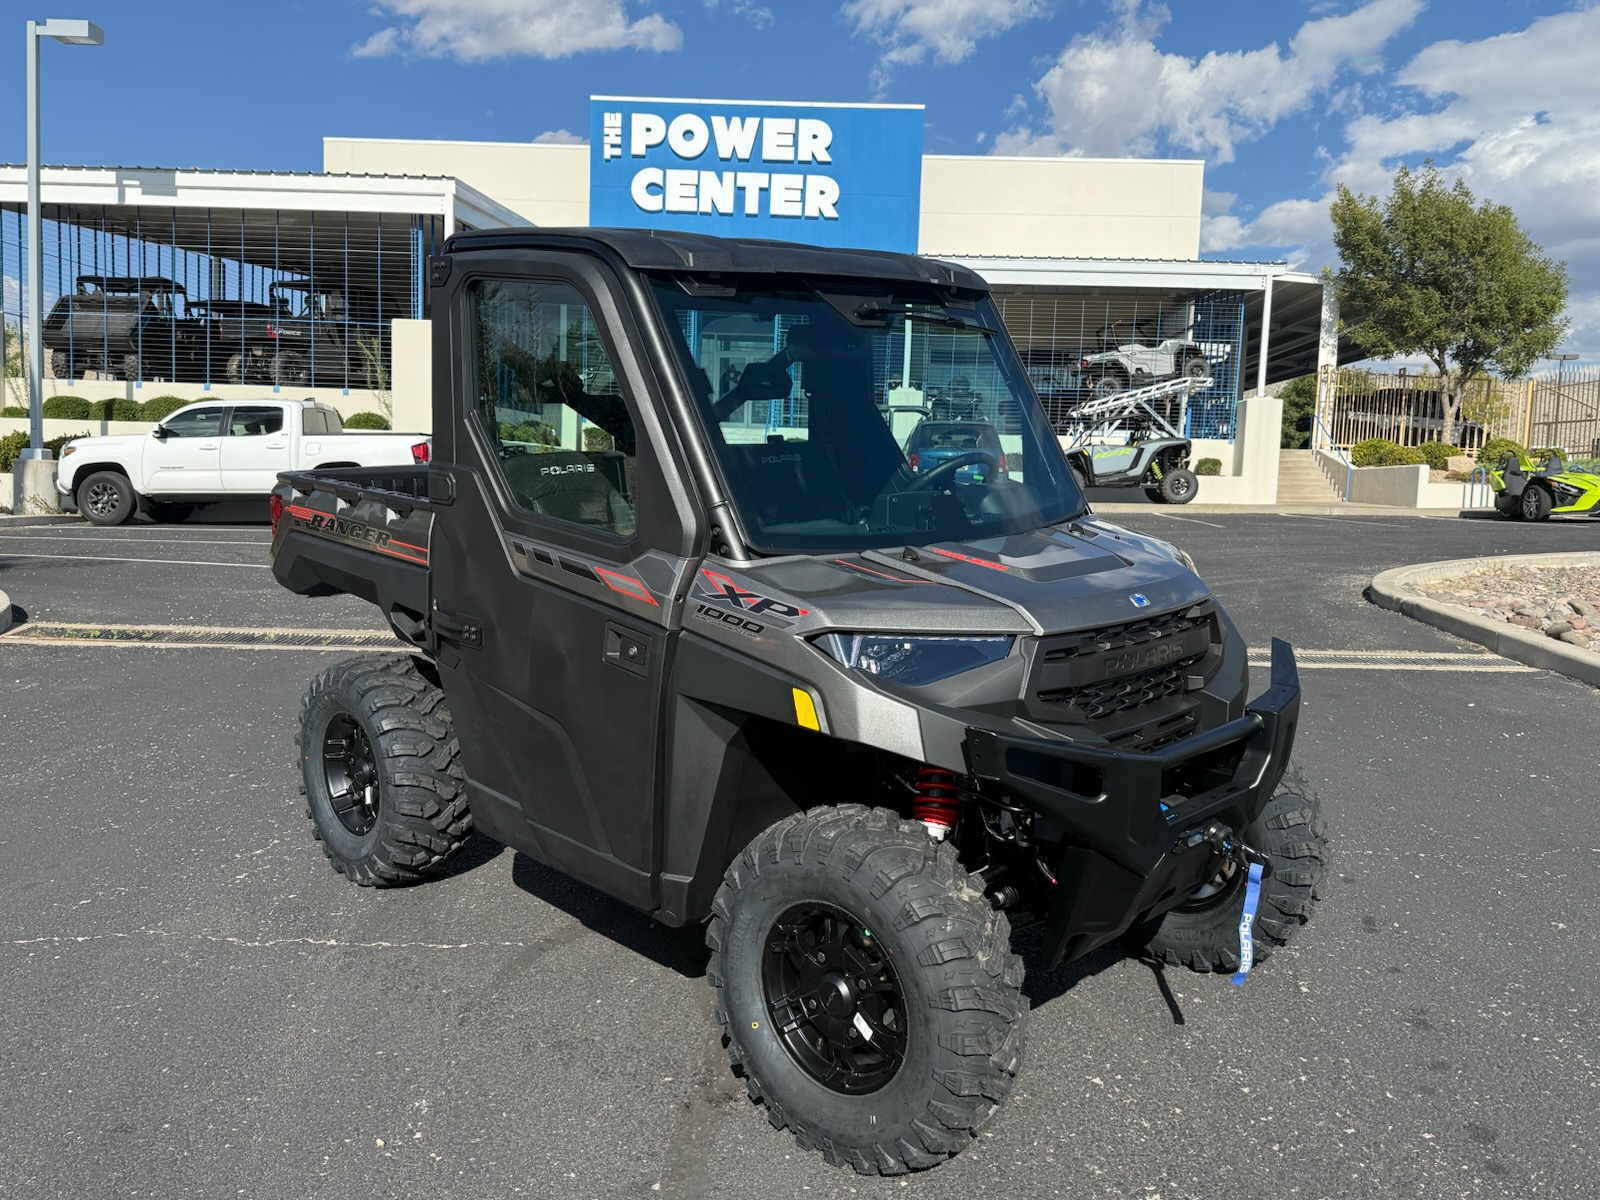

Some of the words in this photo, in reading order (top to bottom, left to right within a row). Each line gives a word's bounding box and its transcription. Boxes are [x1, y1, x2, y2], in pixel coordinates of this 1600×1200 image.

[603, 112, 622, 162] THE
[631, 113, 833, 163] POWER
[631, 167, 840, 220] CENTER
[540, 463, 595, 476] POLARIS
[761, 453, 802, 464] POLARIS
[310, 513, 392, 548] RANGER
[702, 583, 800, 617] XP
[696, 604, 765, 634] 1000
[1104, 643, 1184, 676] POLARIS
[1240, 913, 1253, 974] POLARIS
